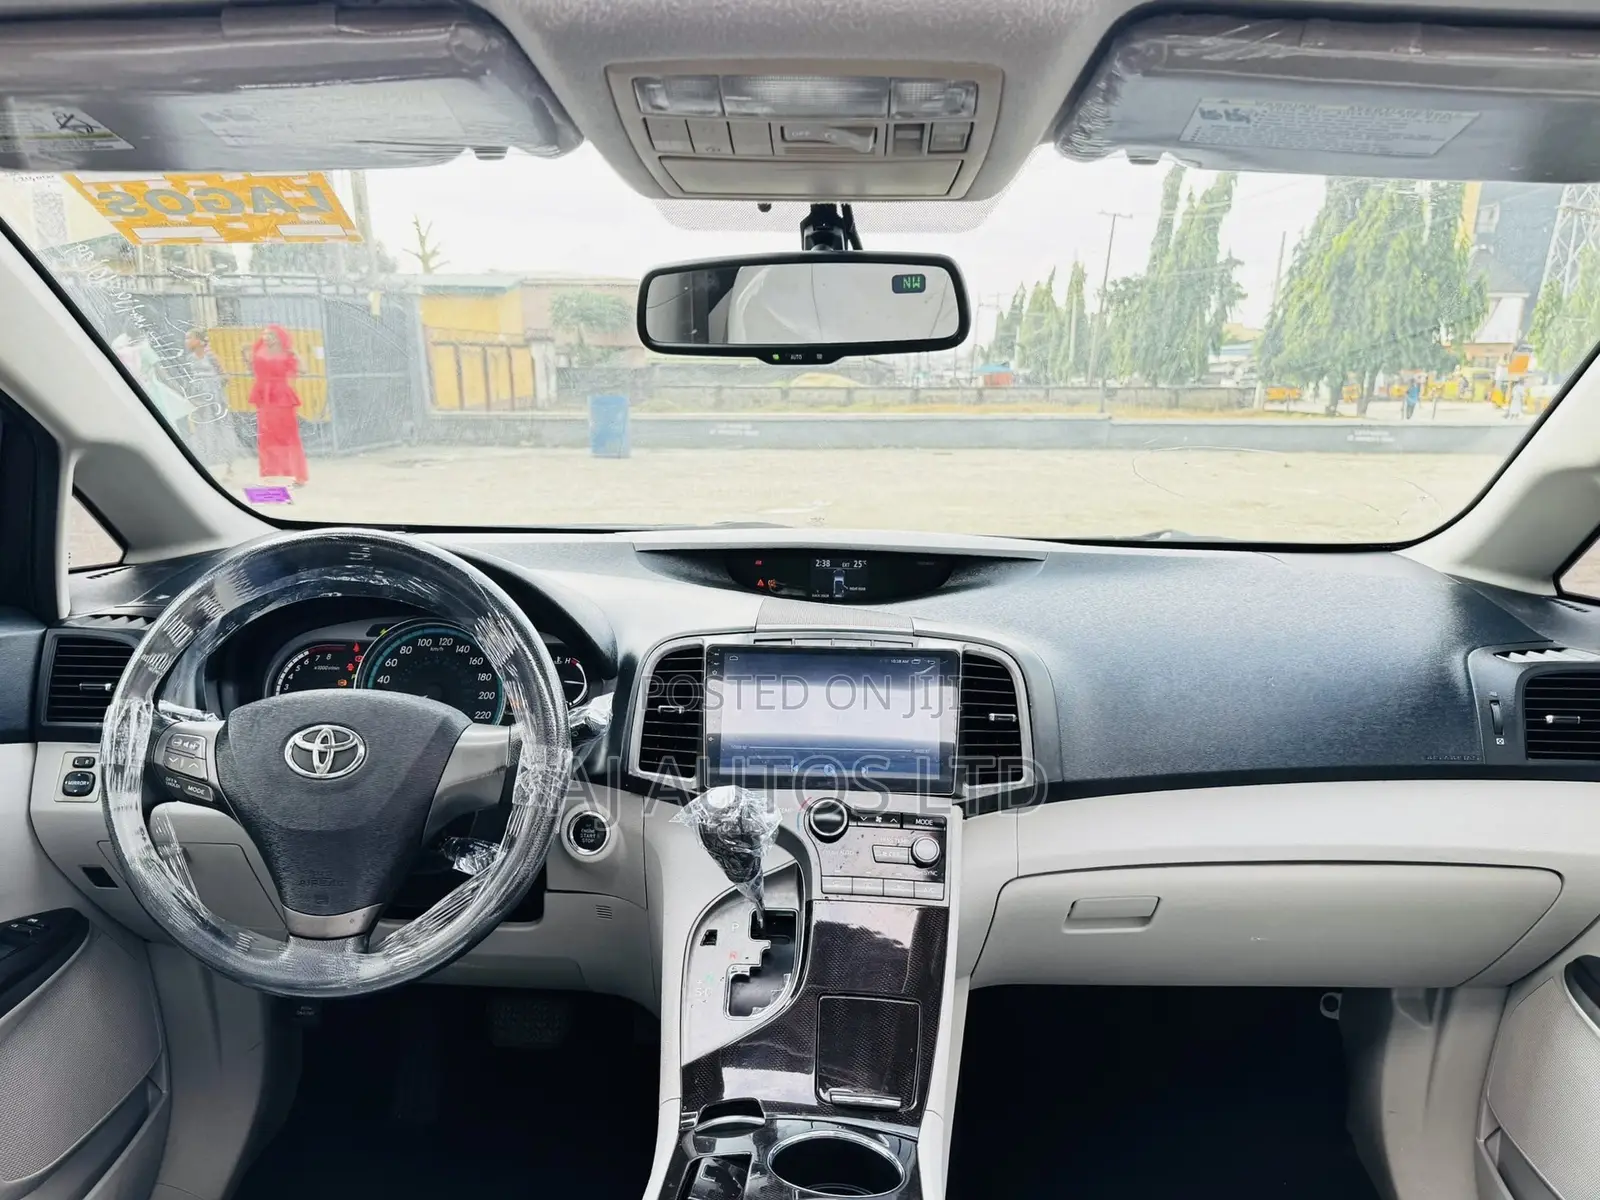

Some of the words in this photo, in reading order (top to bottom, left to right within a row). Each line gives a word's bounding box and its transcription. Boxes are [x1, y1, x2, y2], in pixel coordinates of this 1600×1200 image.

[902, 276, 921, 289] NW
[815, 559, 831, 568] 2:38
[417, 638, 433, 647] 100
[438, 637, 454, 646] 120
[399, 645, 413, 655] 80
[455, 645, 471, 654] 140
[303, 657, 310, 666] 6
[314, 654, 321, 662] 7
[326, 653, 332, 661] 8
[468, 656, 484, 666] 160
[384, 658, 398, 667] 60
[295, 664, 302, 672] 5
[287, 673, 294, 681] 4
[377, 675, 391, 684] 40
[477, 672, 492, 682] 180
[283, 683, 290, 691] 3
[478, 691, 496, 701] 200
[474, 710, 492, 720] 220
[187, 785, 205, 796] MODE
[915, 818, 934, 826] MODE
[731, 922, 740, 932] P
